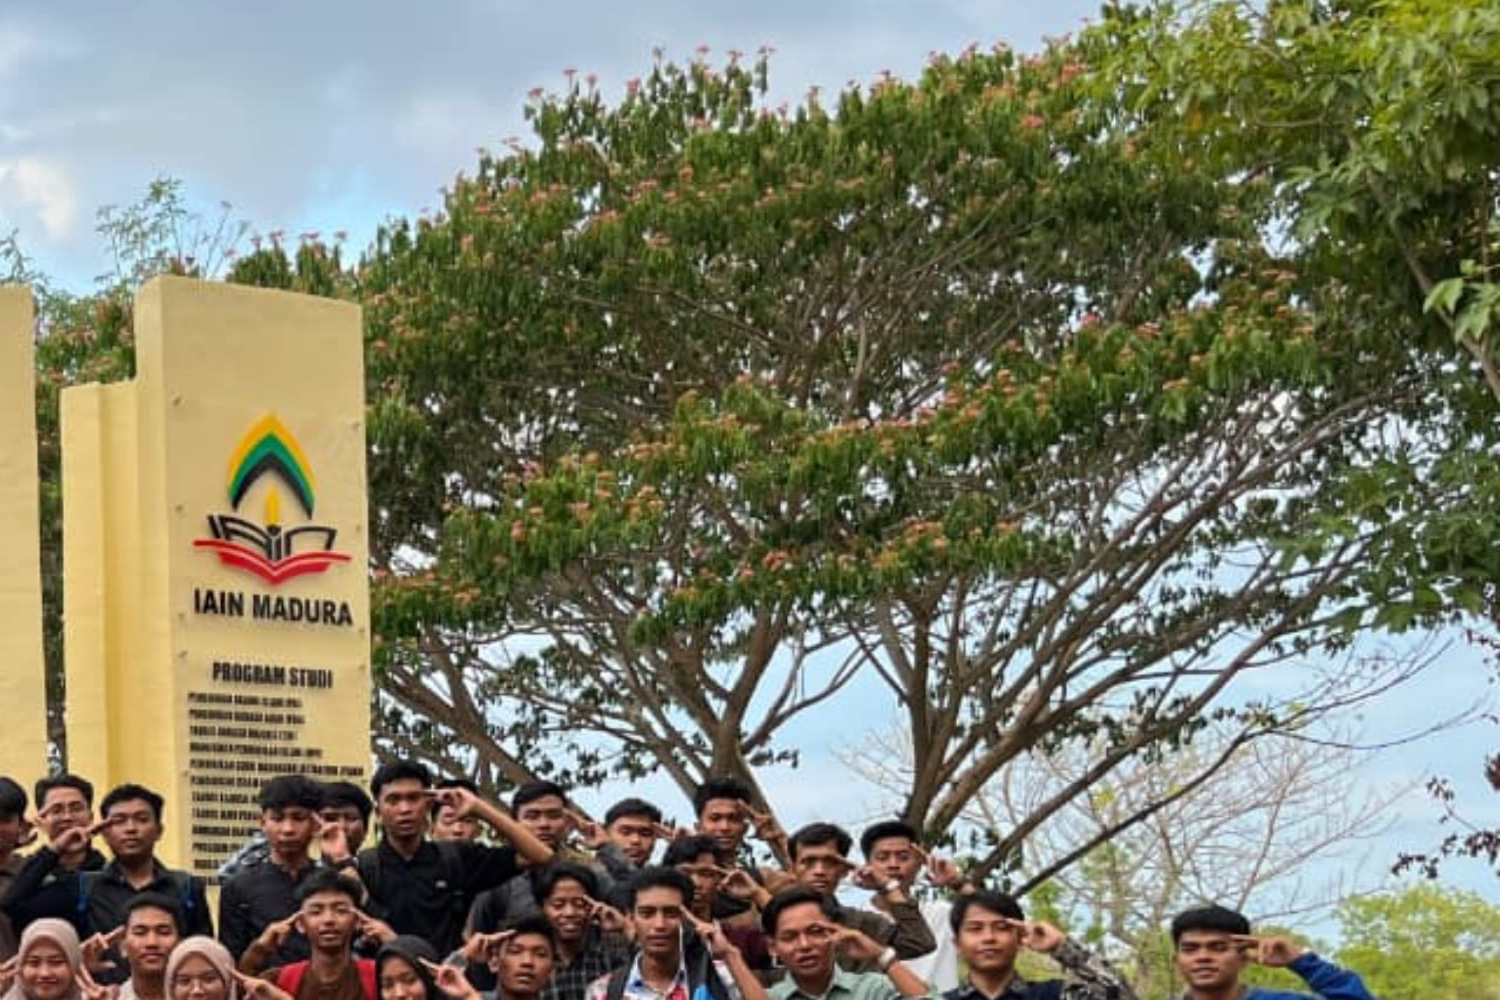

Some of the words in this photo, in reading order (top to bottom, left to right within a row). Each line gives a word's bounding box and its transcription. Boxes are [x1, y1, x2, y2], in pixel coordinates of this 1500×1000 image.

[194, 588, 244, 617] IAIN
[252, 594, 353, 627] MADURA
[212, 662, 286, 685] PROGRAM
[289, 667, 333, 689] STUDI
